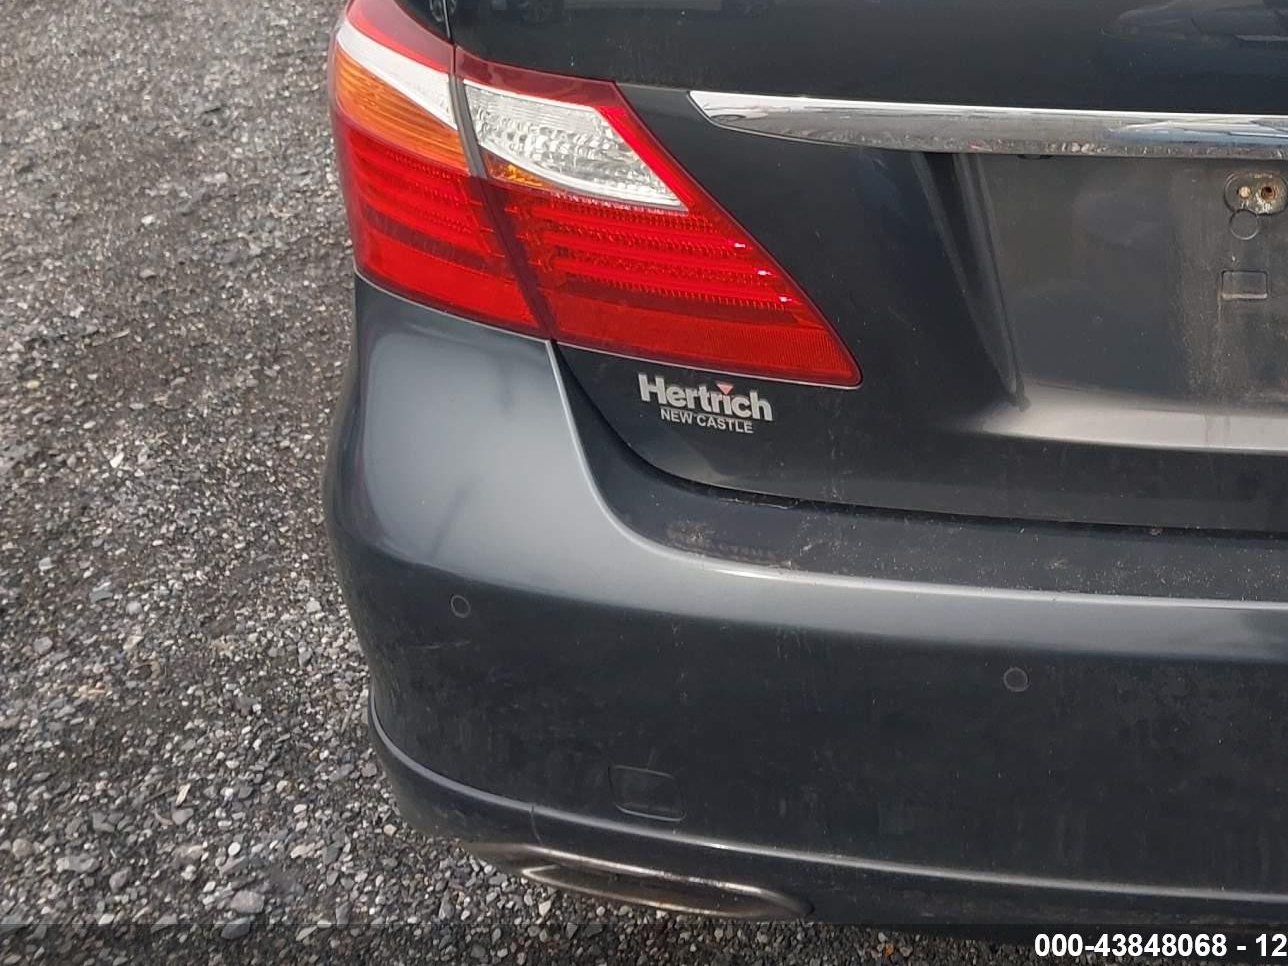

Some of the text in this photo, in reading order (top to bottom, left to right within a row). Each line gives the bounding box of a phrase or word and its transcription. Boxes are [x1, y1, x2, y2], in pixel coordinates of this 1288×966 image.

[637, 372, 773, 421] Hertrich
[660, 407, 754, 434] NEW CASTLE
